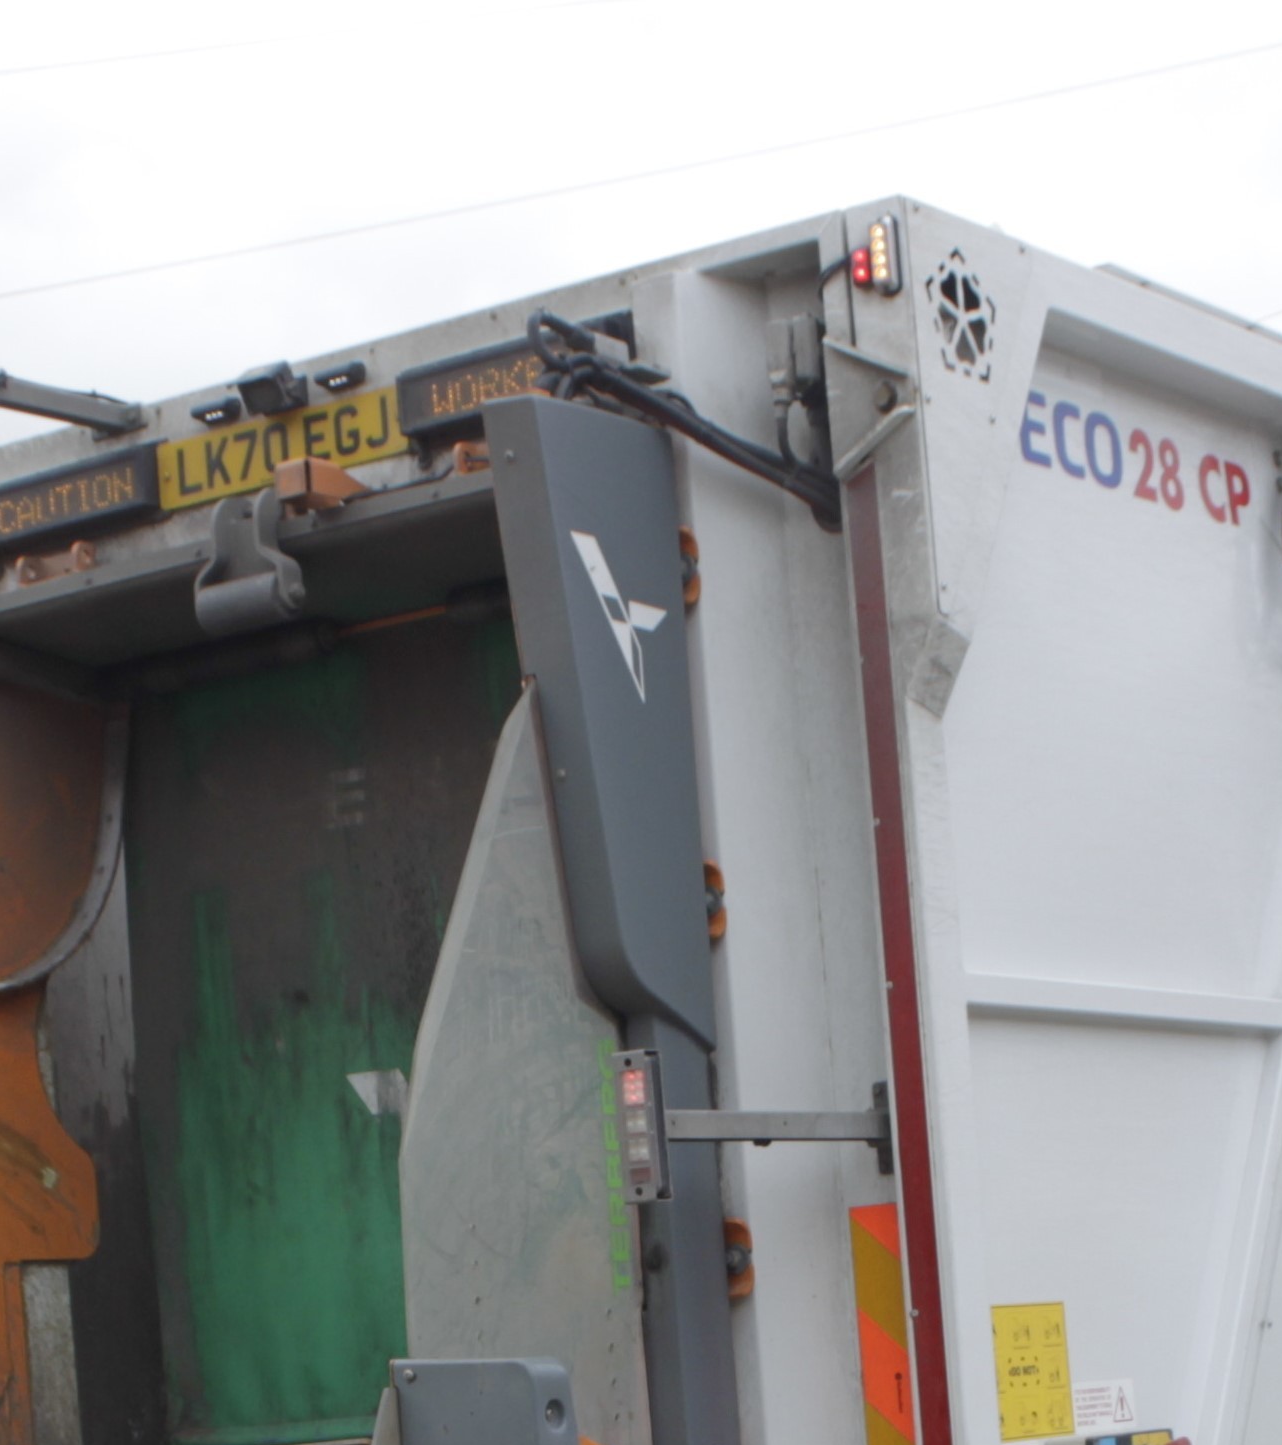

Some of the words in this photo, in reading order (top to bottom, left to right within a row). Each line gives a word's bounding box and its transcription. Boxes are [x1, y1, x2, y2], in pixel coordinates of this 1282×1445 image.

[176, 421, 289, 497] LK70
[302, 395, 389, 460] EGJ
[1198, 453, 1251, 526] CP
